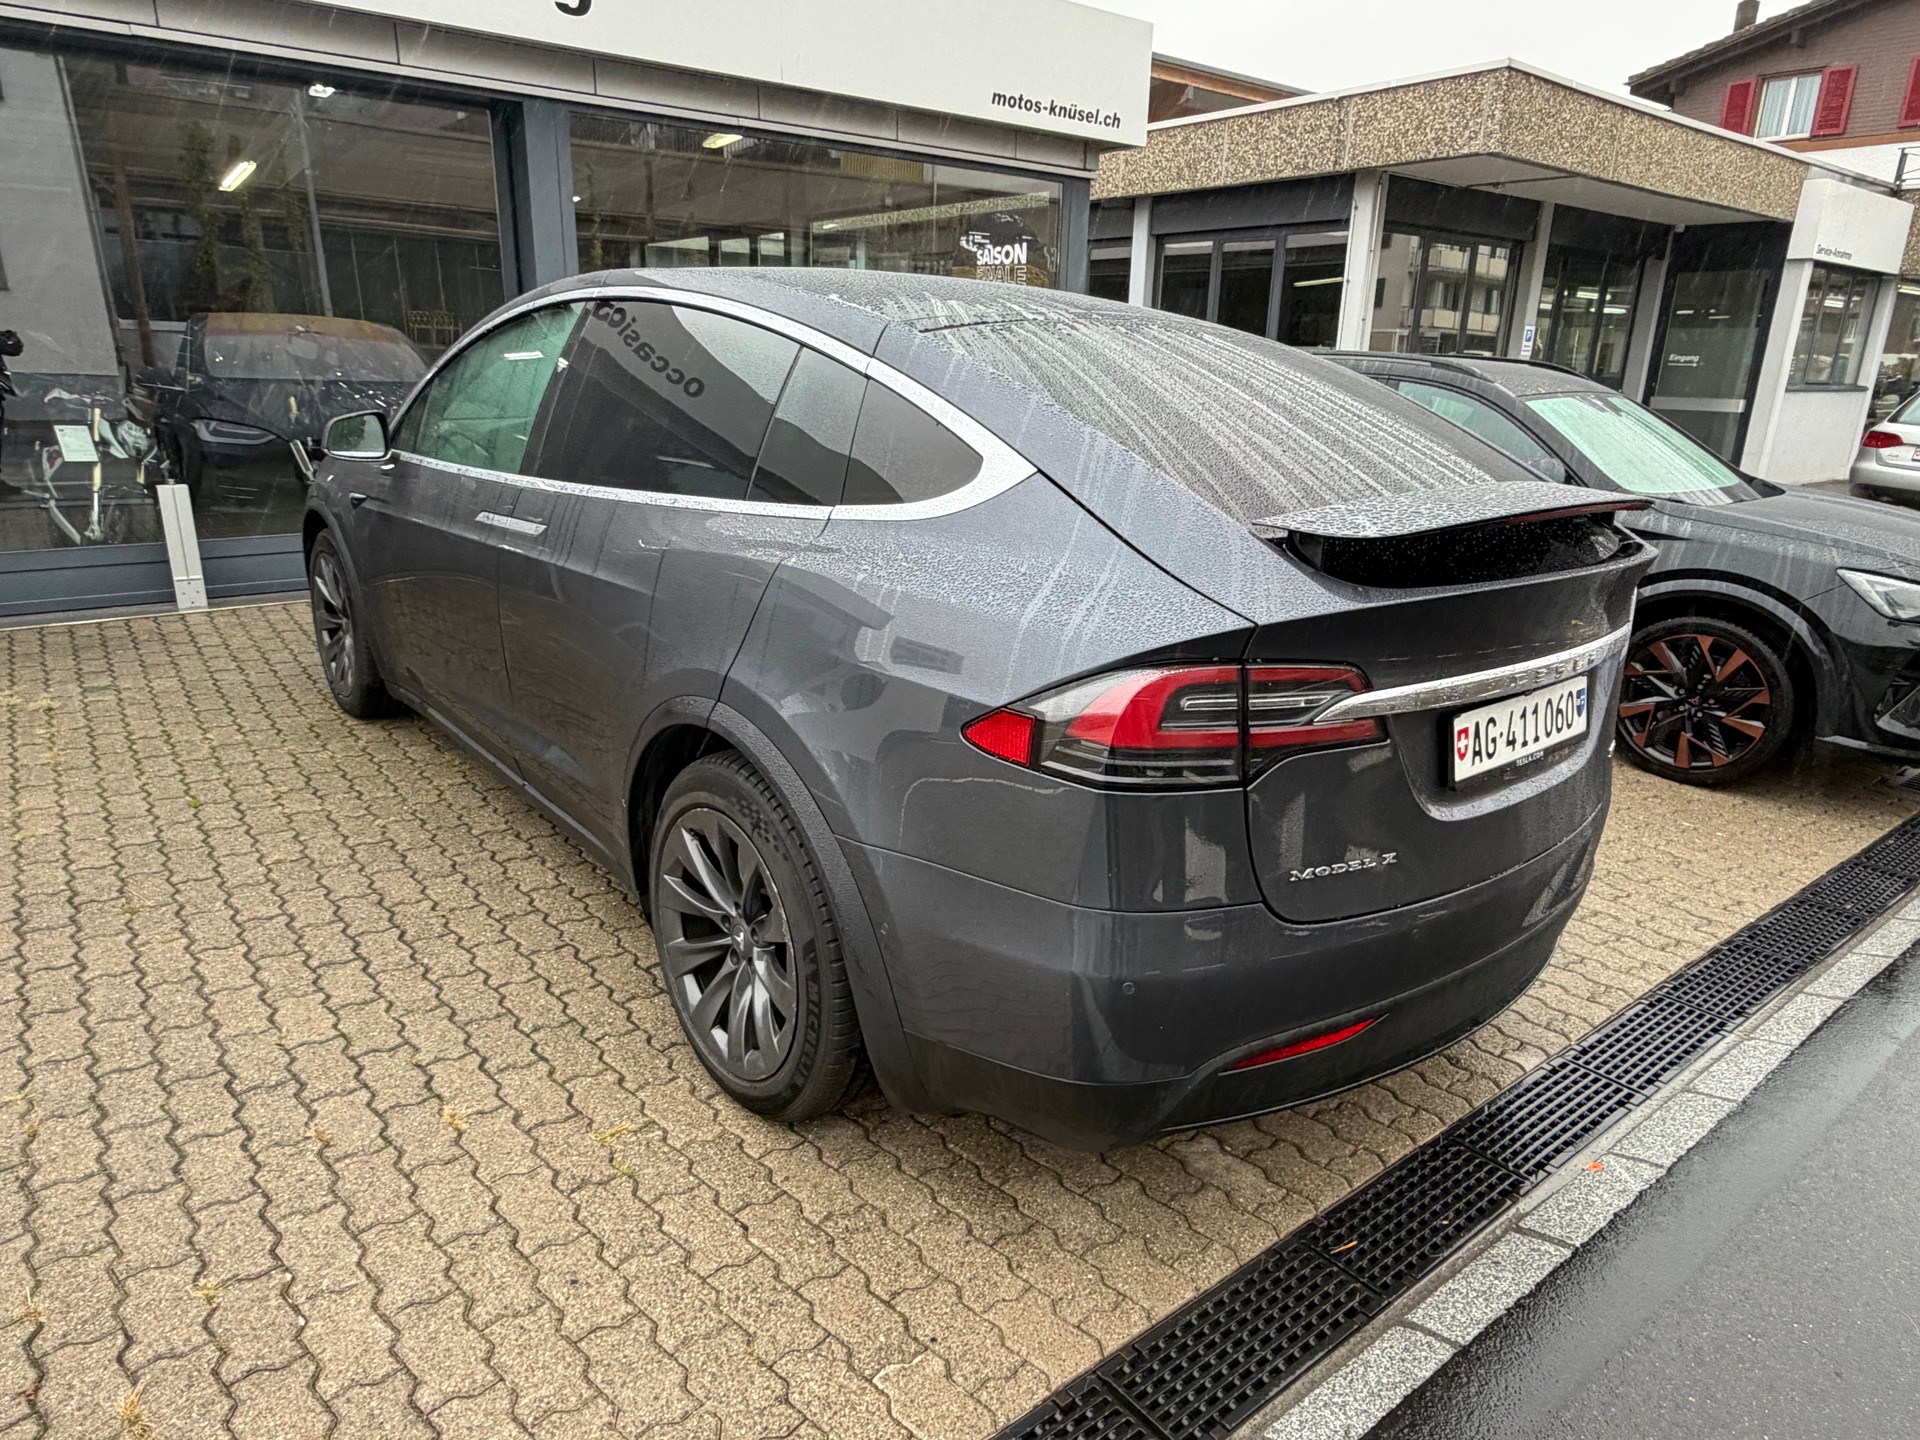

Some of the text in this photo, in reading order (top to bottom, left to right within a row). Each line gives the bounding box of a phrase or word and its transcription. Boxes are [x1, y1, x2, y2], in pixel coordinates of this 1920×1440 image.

[991, 92, 1121, 129] motos-knüsel.ch
[976, 242, 1028, 265] SAISON
[1289, 852, 1397, 882] MODEL X
